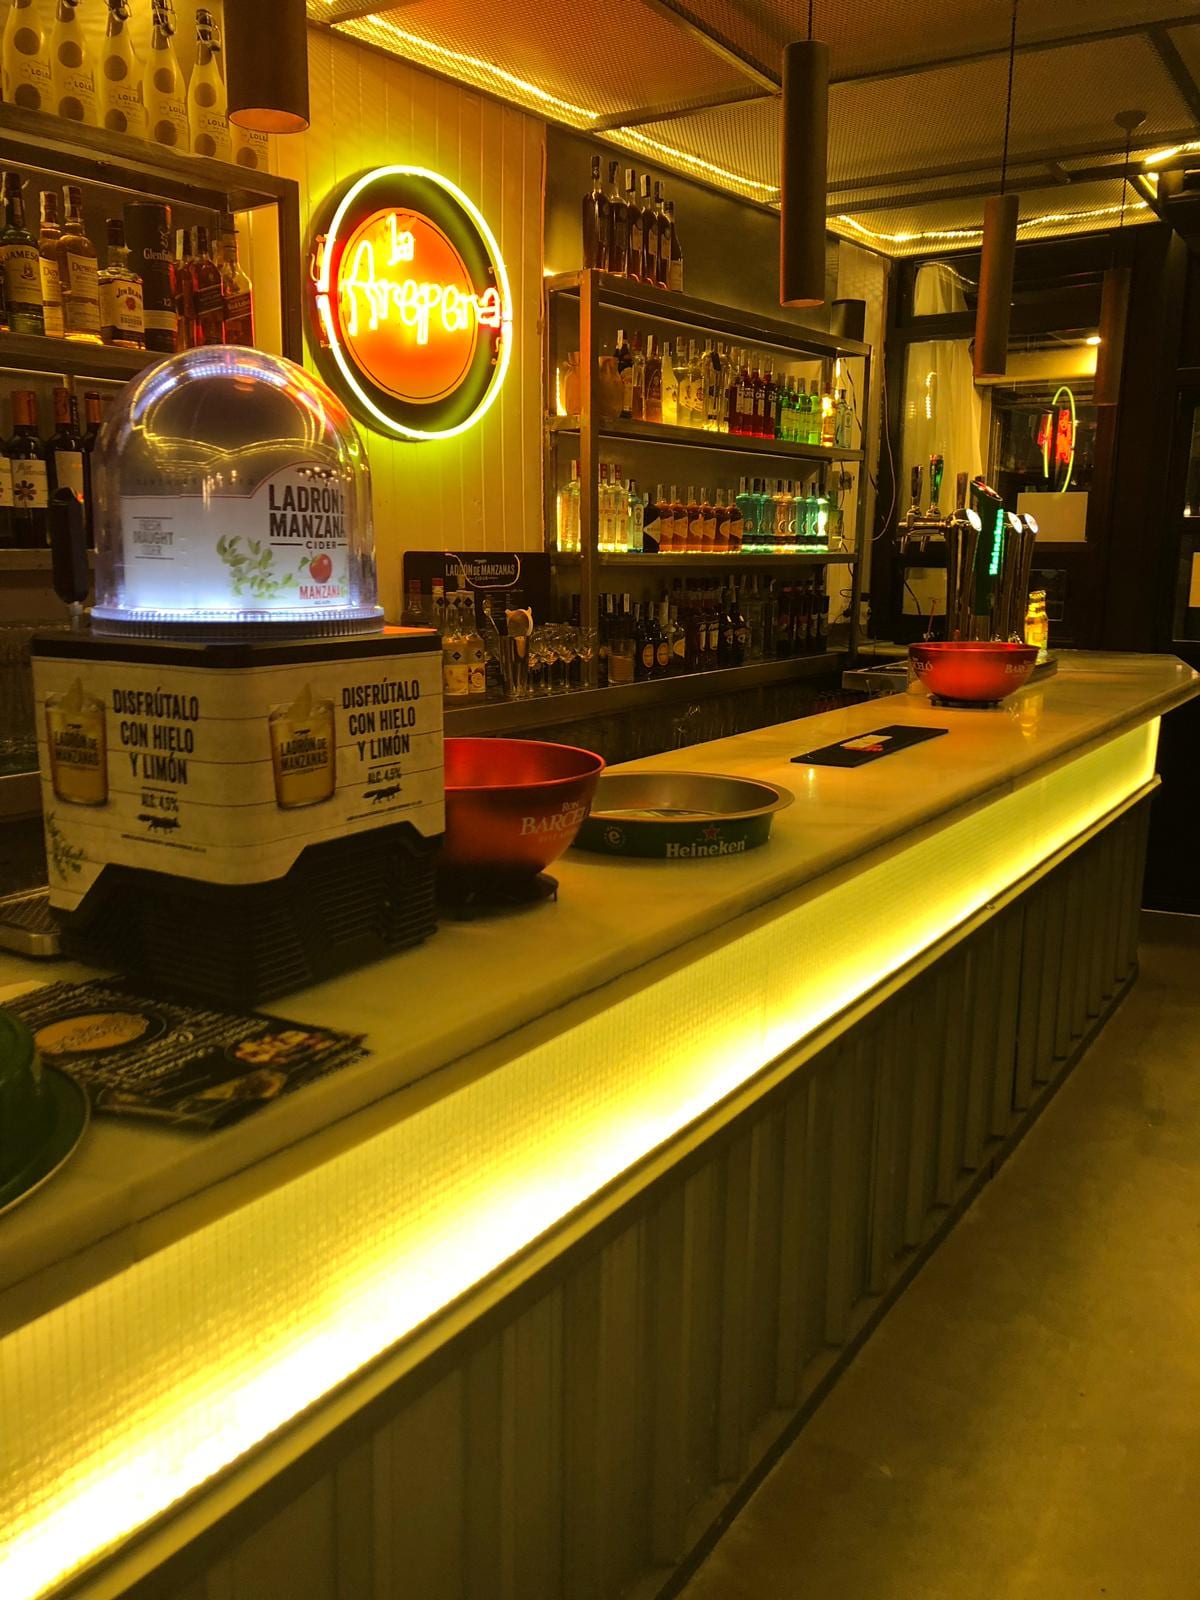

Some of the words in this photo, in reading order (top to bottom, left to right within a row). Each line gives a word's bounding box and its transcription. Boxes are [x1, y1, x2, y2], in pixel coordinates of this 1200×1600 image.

[269, 481, 339, 513] LADRÓN
[269, 512, 346, 538] MANZANA
[305, 540, 337, 550] CIDER
[112, 686, 200, 721] DISFRÚTALO
[342, 677, 420, 710] DISFRÚTALO
[120, 721, 149, 747] CON
[153, 724, 194, 753] HIELO
[349, 712, 375, 736] CON
[380, 706, 416, 731] HIELO
[357, 741, 366, 762] Y
[370, 730, 410, 760] LIMÓN
[129, 752, 138, 777] Y
[143, 752, 188, 785] LIMÓN
[665, 840, 746, 858] Heineken
